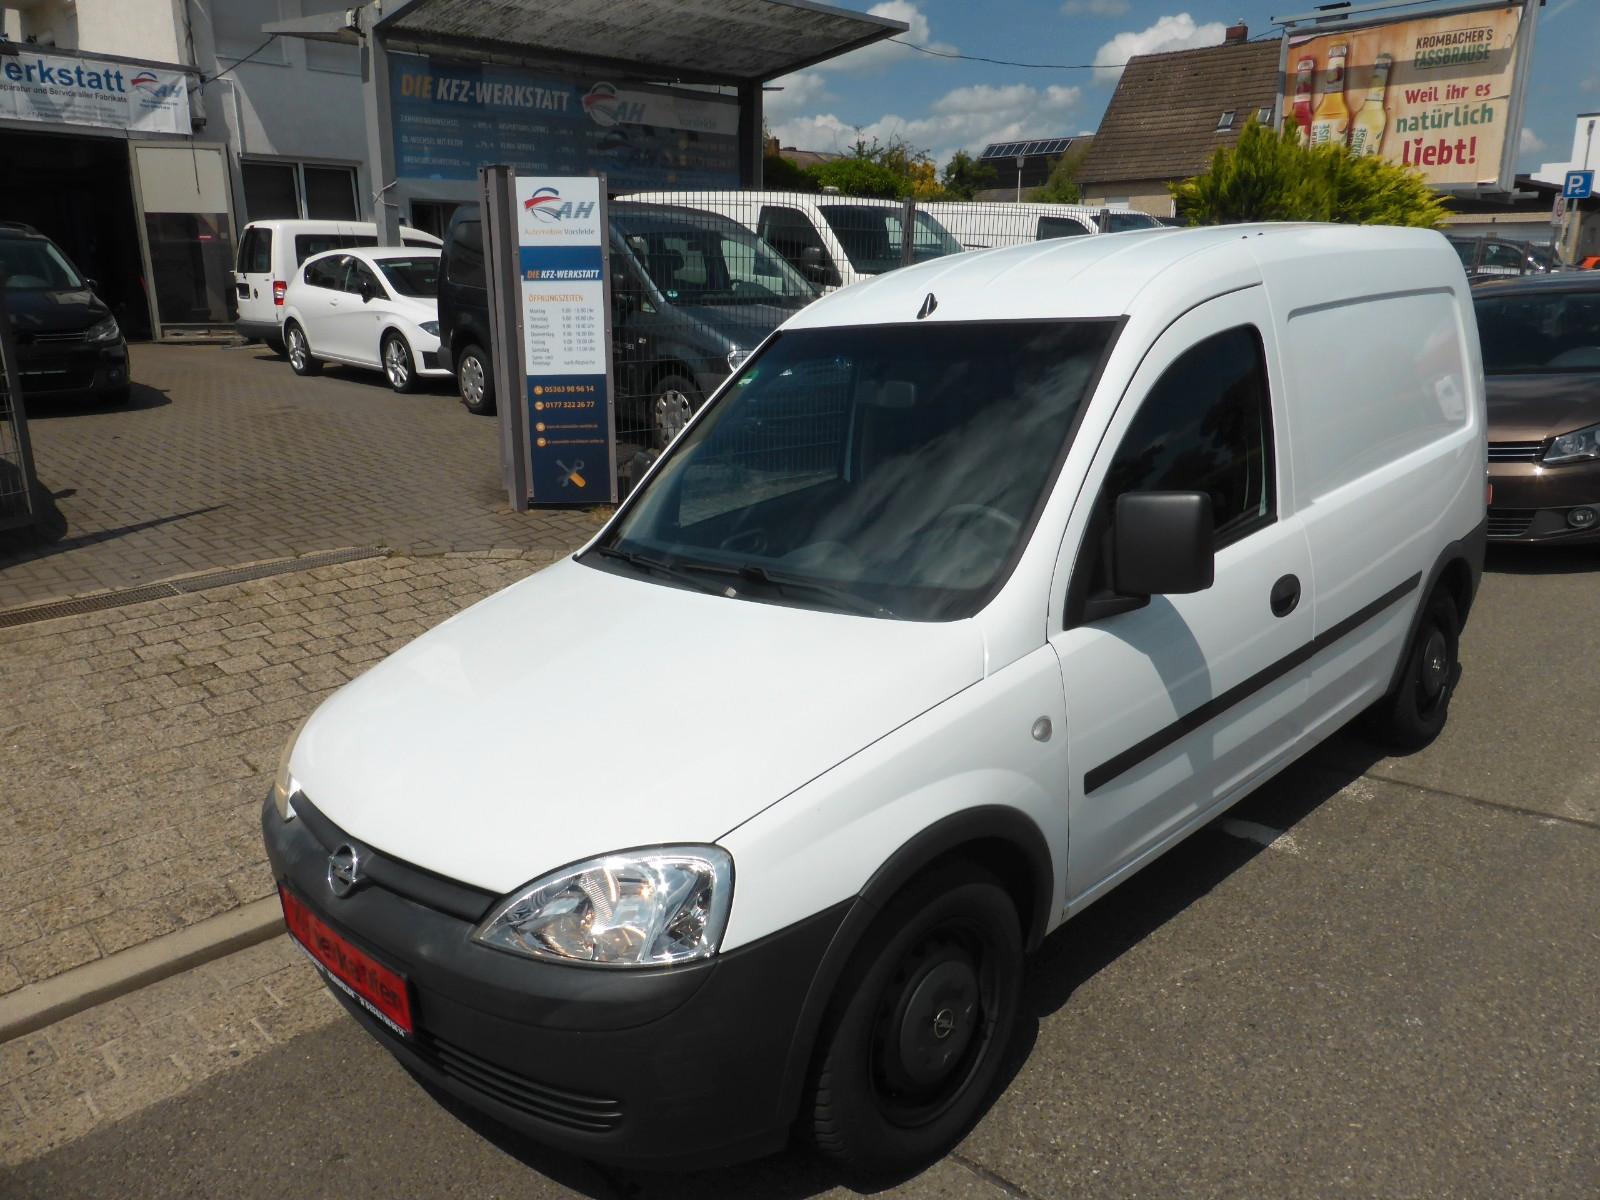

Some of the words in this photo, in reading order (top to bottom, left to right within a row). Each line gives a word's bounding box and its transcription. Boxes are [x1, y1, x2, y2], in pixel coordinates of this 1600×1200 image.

[1416, 28, 1493, 49] KROMBACHER'S
[1414, 43, 1492, 68] FASSBRAUSE
[0, 57, 126, 93] erkstatt
[401, 73, 432, 98] DIE
[437, 77, 570, 111] KFZ-WERKSTATT
[1405, 86, 1439, 104] Weil
[1446, 84, 1469, 100] ihr
[1475, 83, 1491, 96] es
[1396, 103, 1493, 133] natürlich
[1402, 136, 1477, 166] liebt!
[1567, 175, 1584, 194] P
[559, 201, 596, 219] AH
[527, 269, 540, 279] DIE
[541, 269, 600, 279] KFZ-WERKSTATT
